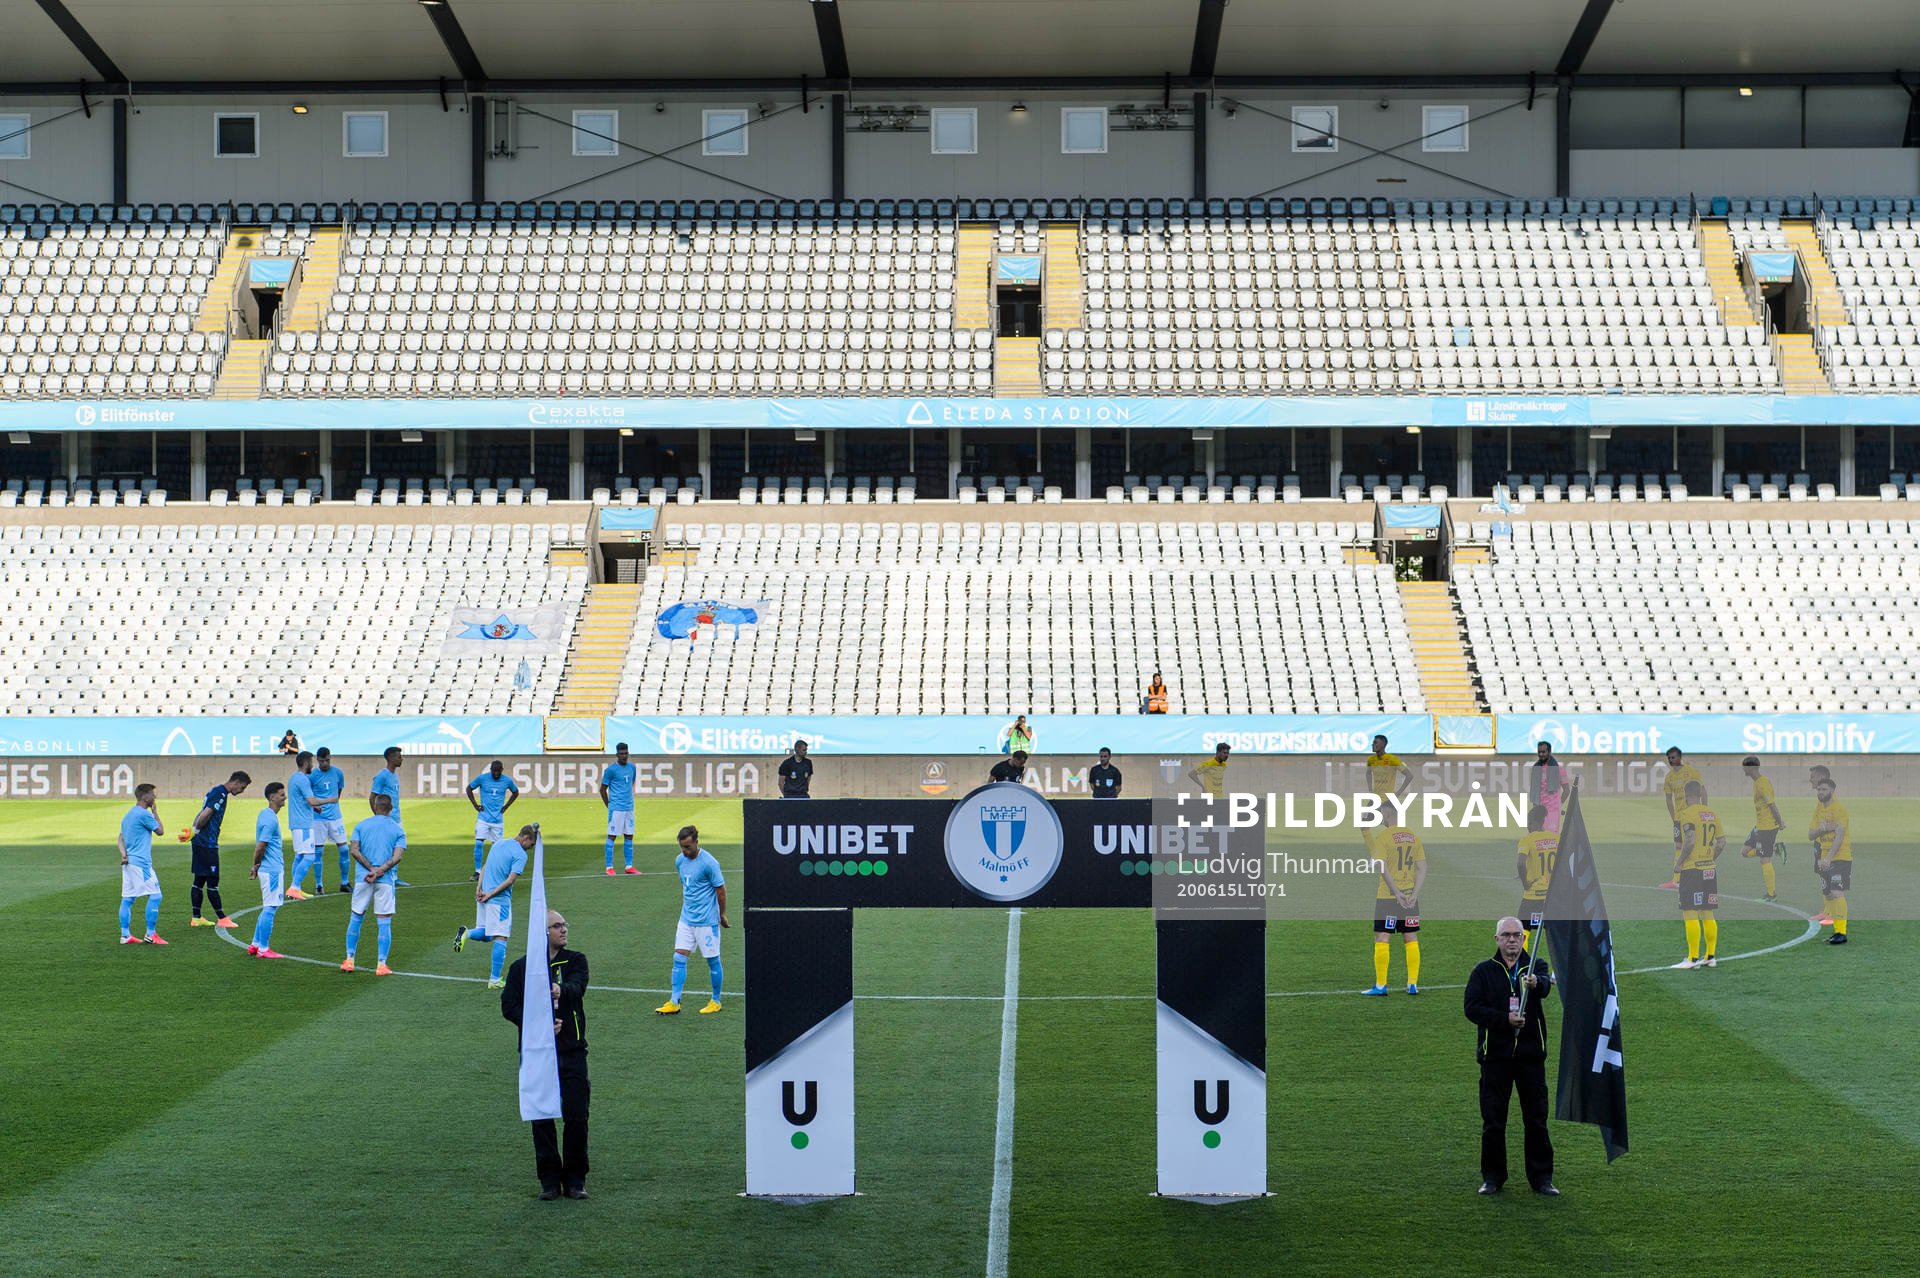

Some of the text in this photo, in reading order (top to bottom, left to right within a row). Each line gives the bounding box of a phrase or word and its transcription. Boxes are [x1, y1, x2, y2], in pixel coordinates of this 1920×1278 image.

[101, 407, 176, 423] Elitfönster
[550, 404, 625, 417] exakta
[943, 406, 1130, 421] ELEDA STADION
[1426, 529, 1438, 539] 24
[0, 740, 110, 752] CABONLINE
[701, 728, 824, 751] Elitfönster
[1571, 722, 1663, 754] bemt
[1742, 722, 1877, 754] Simplify
[61, 763, 135, 795] LIGA
[685, 762, 759, 794] LIGA
[1597, 761, 1671, 793] LIGA
[772, 824, 915, 856] UNIBET
[1093, 824, 1236, 856] UNIBET
[1701, 823, 1716, 847] 12
[978, 855, 1031, 873] Malmö FF
[1396, 845, 1414, 872] 14
[704, 935, 713, 948] 2
[782, 1080, 818, 1127] U
[1194, 1079, 1230, 1126] U
